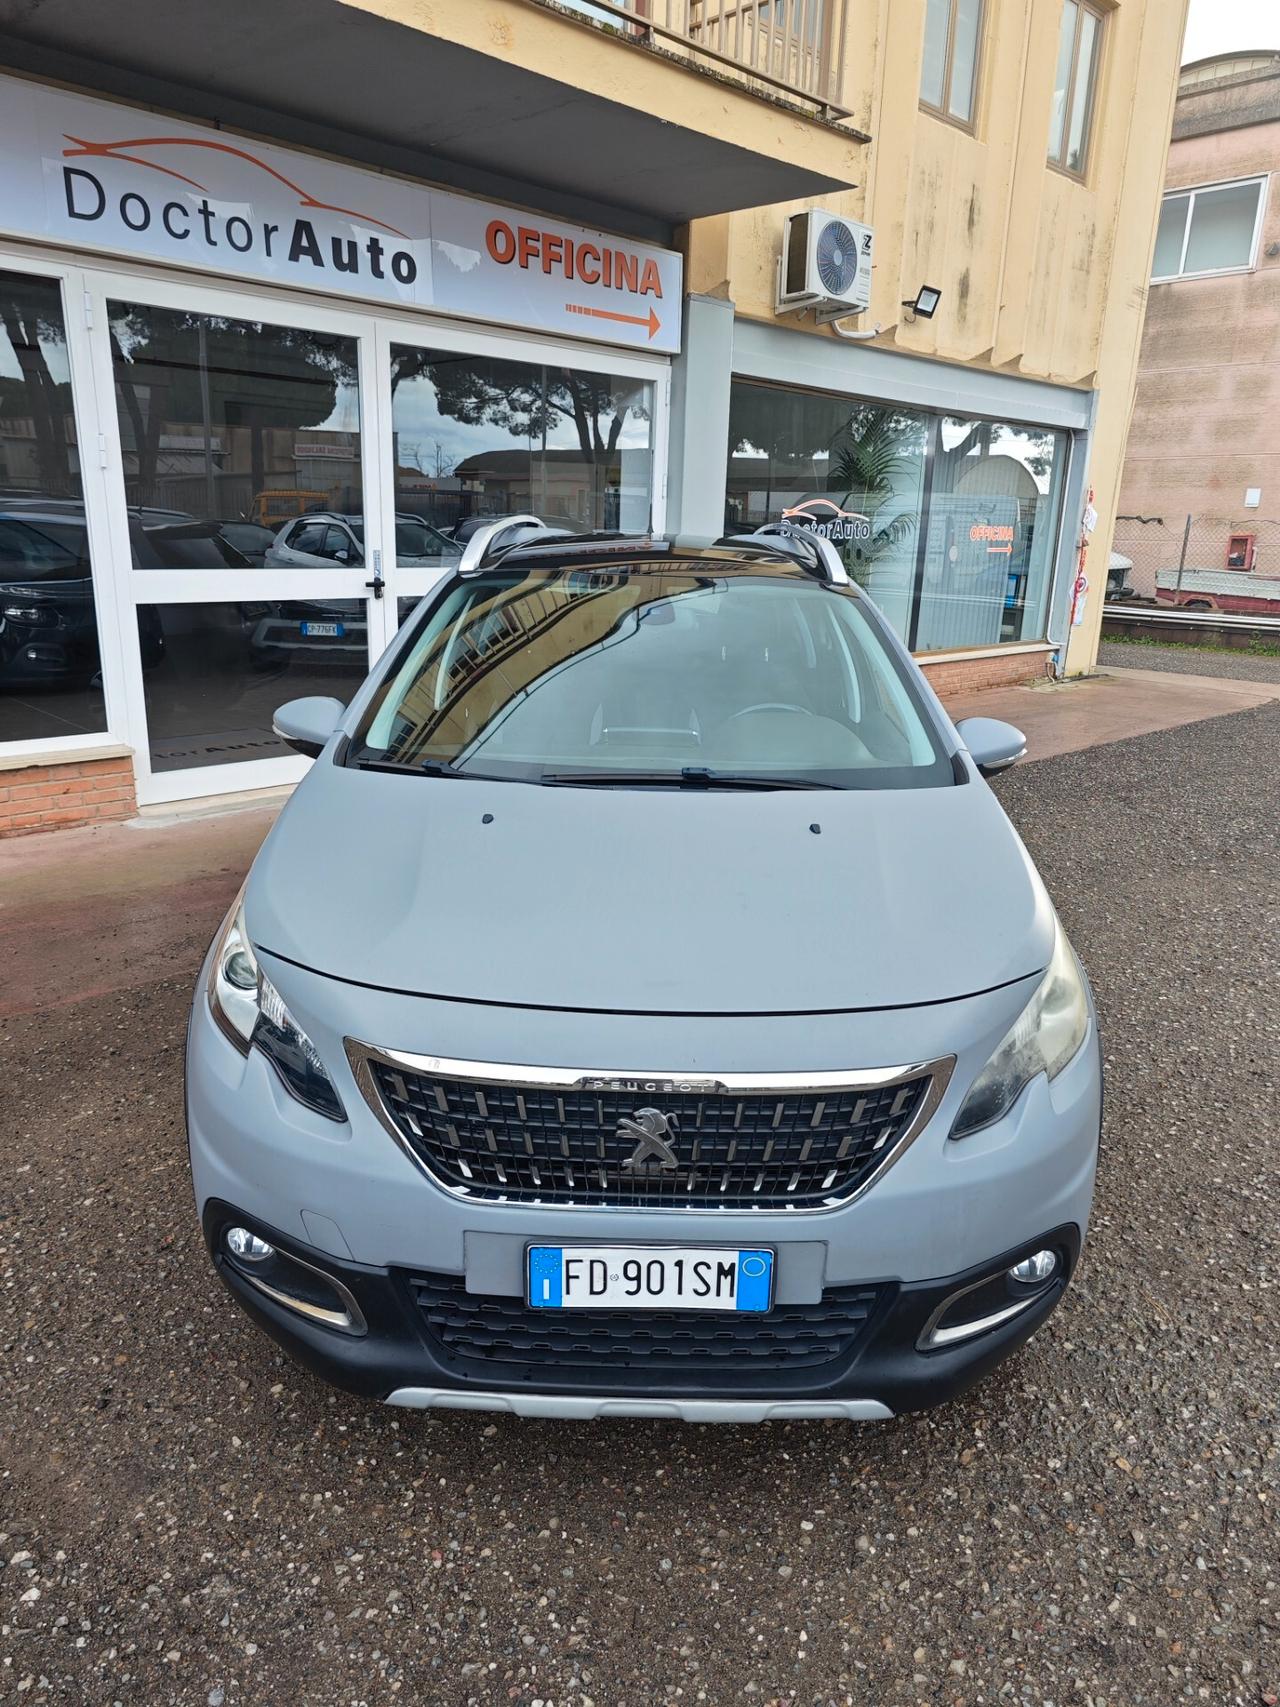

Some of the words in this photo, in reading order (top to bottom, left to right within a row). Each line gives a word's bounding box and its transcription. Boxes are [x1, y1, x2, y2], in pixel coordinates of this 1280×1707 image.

[62, 165, 417, 285] DoctorAuto
[485, 219, 663, 299] OFFICINA
[781, 519, 870, 539] DtorAuto
[970, 525, 1014, 542] OFFICINA
[154, 740, 281, 759] torAuto
[593, 1081, 707, 1092] PEUGEOT
